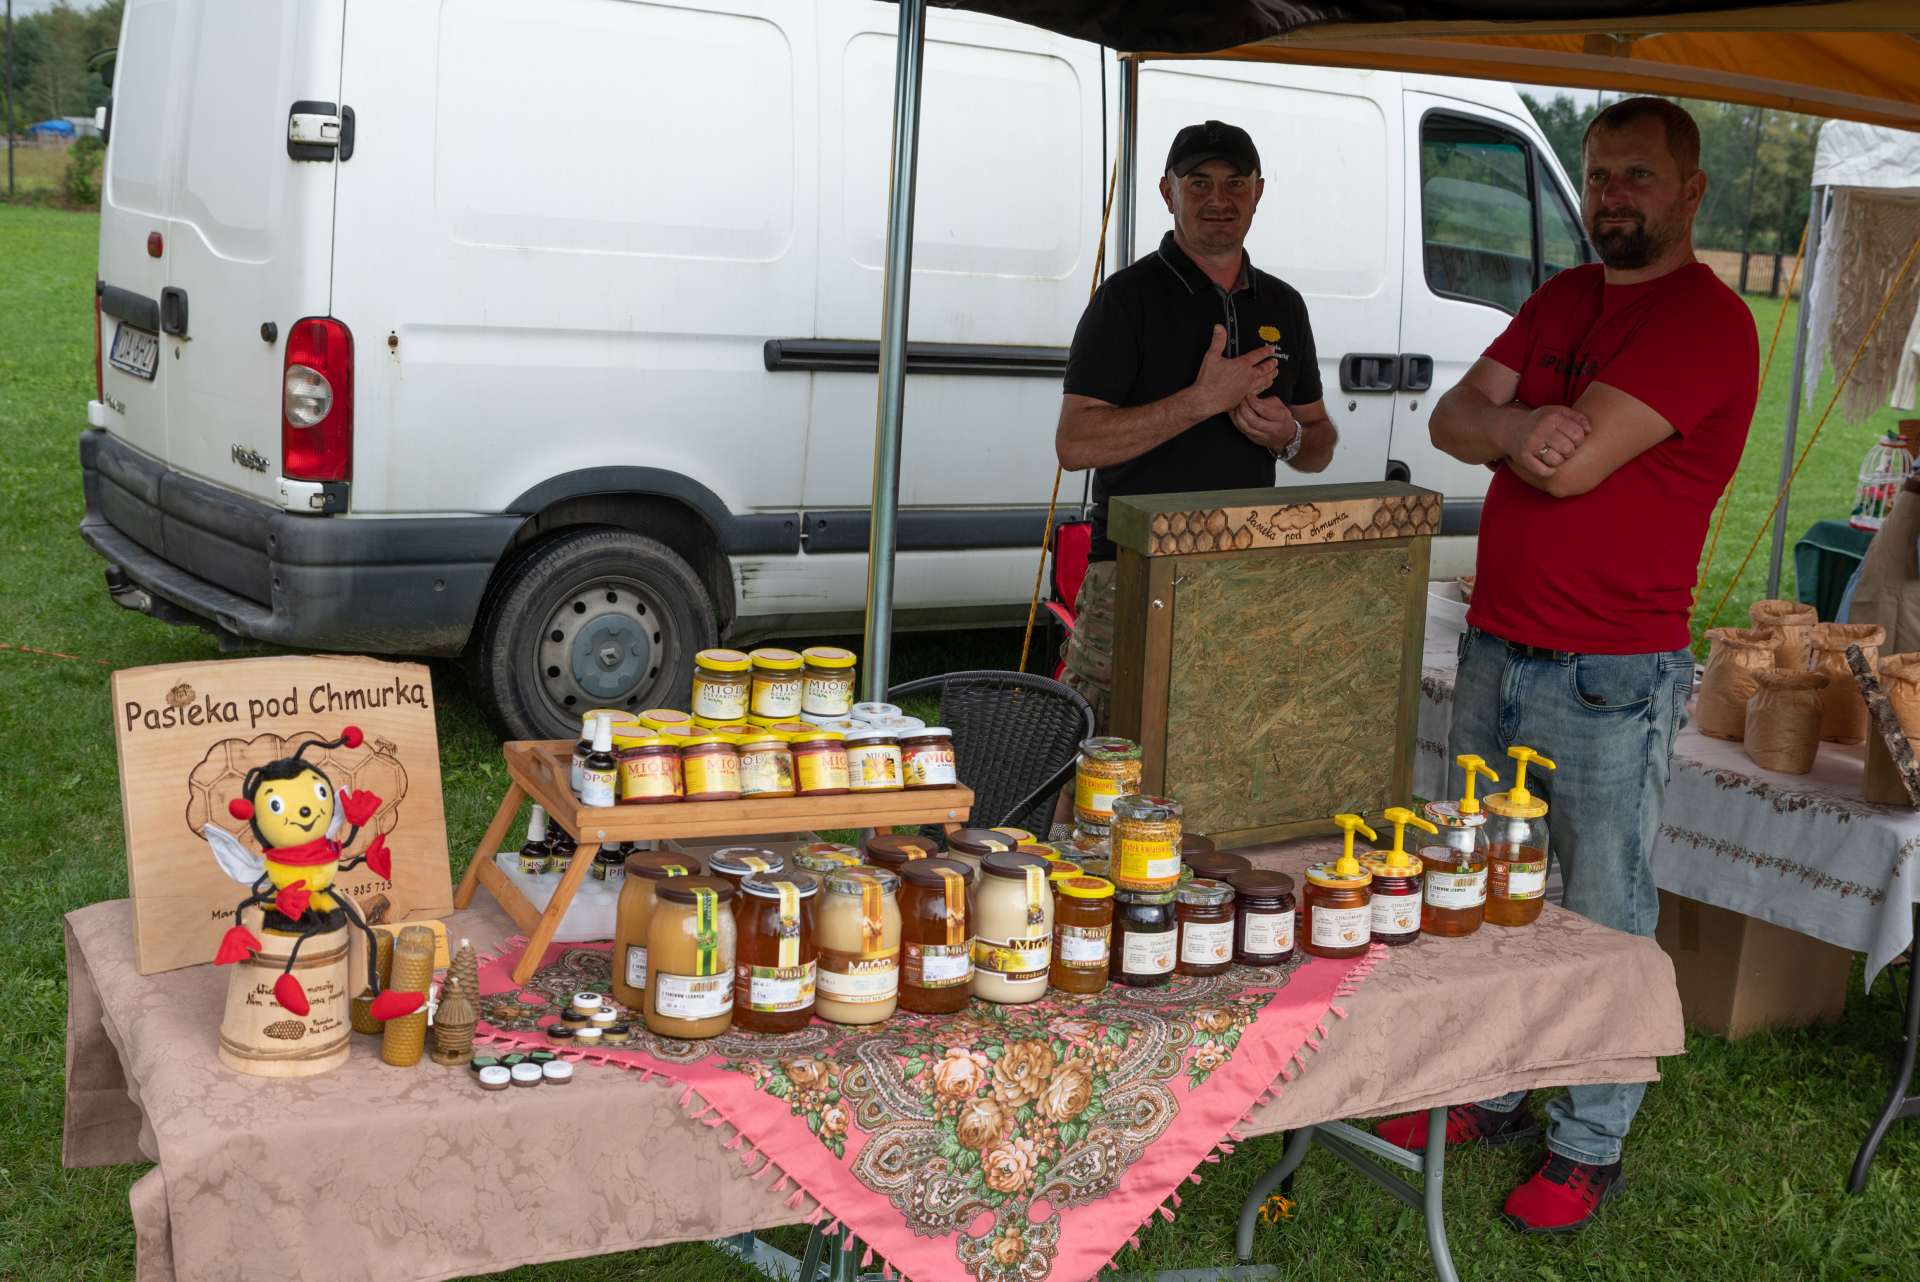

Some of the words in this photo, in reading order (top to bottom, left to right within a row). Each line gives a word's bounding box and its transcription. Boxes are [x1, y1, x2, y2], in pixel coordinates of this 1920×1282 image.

[125, 694, 239, 732] Pasieka
[249, 686, 298, 728] pod
[308, 676, 429, 714] Chmurką
